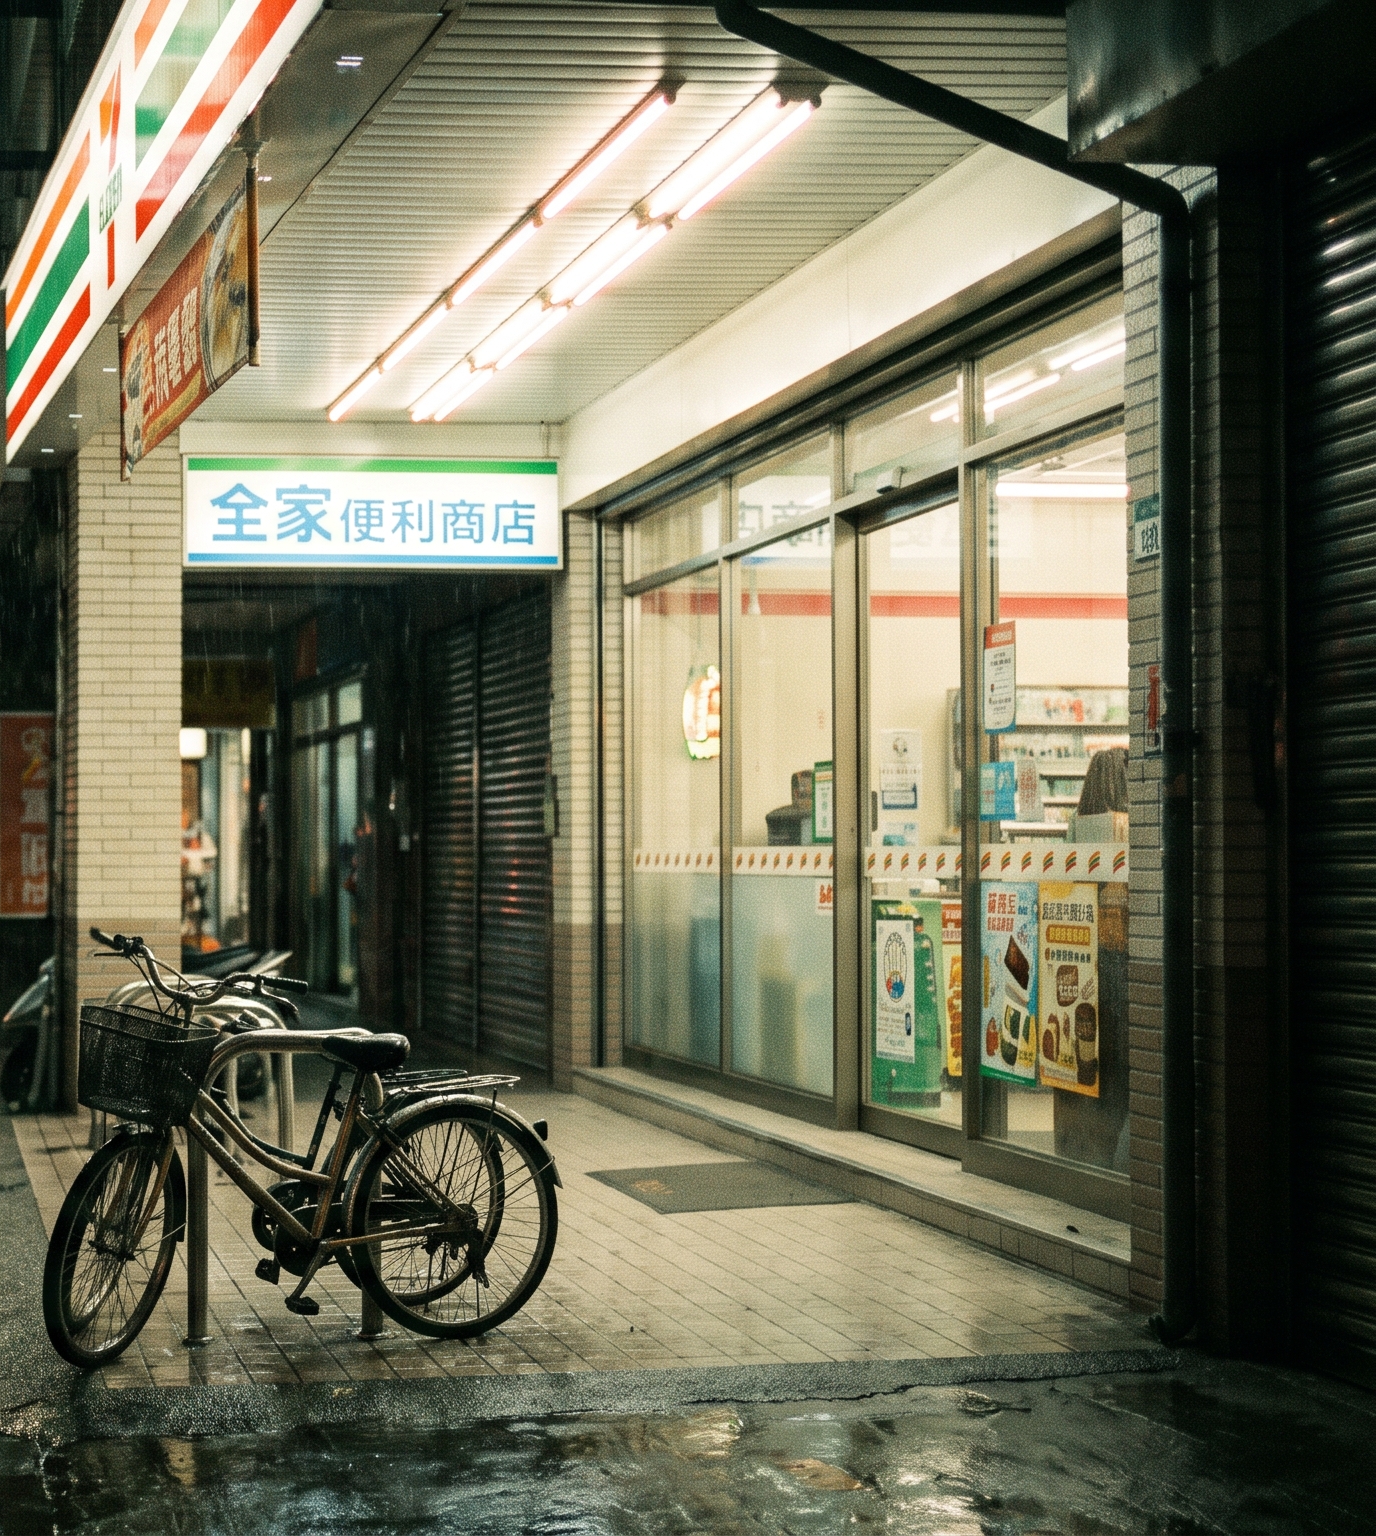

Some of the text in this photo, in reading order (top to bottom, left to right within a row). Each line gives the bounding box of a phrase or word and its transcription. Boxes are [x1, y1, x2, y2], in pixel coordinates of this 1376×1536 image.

[209, 482, 536, 545] 全家便利商店
